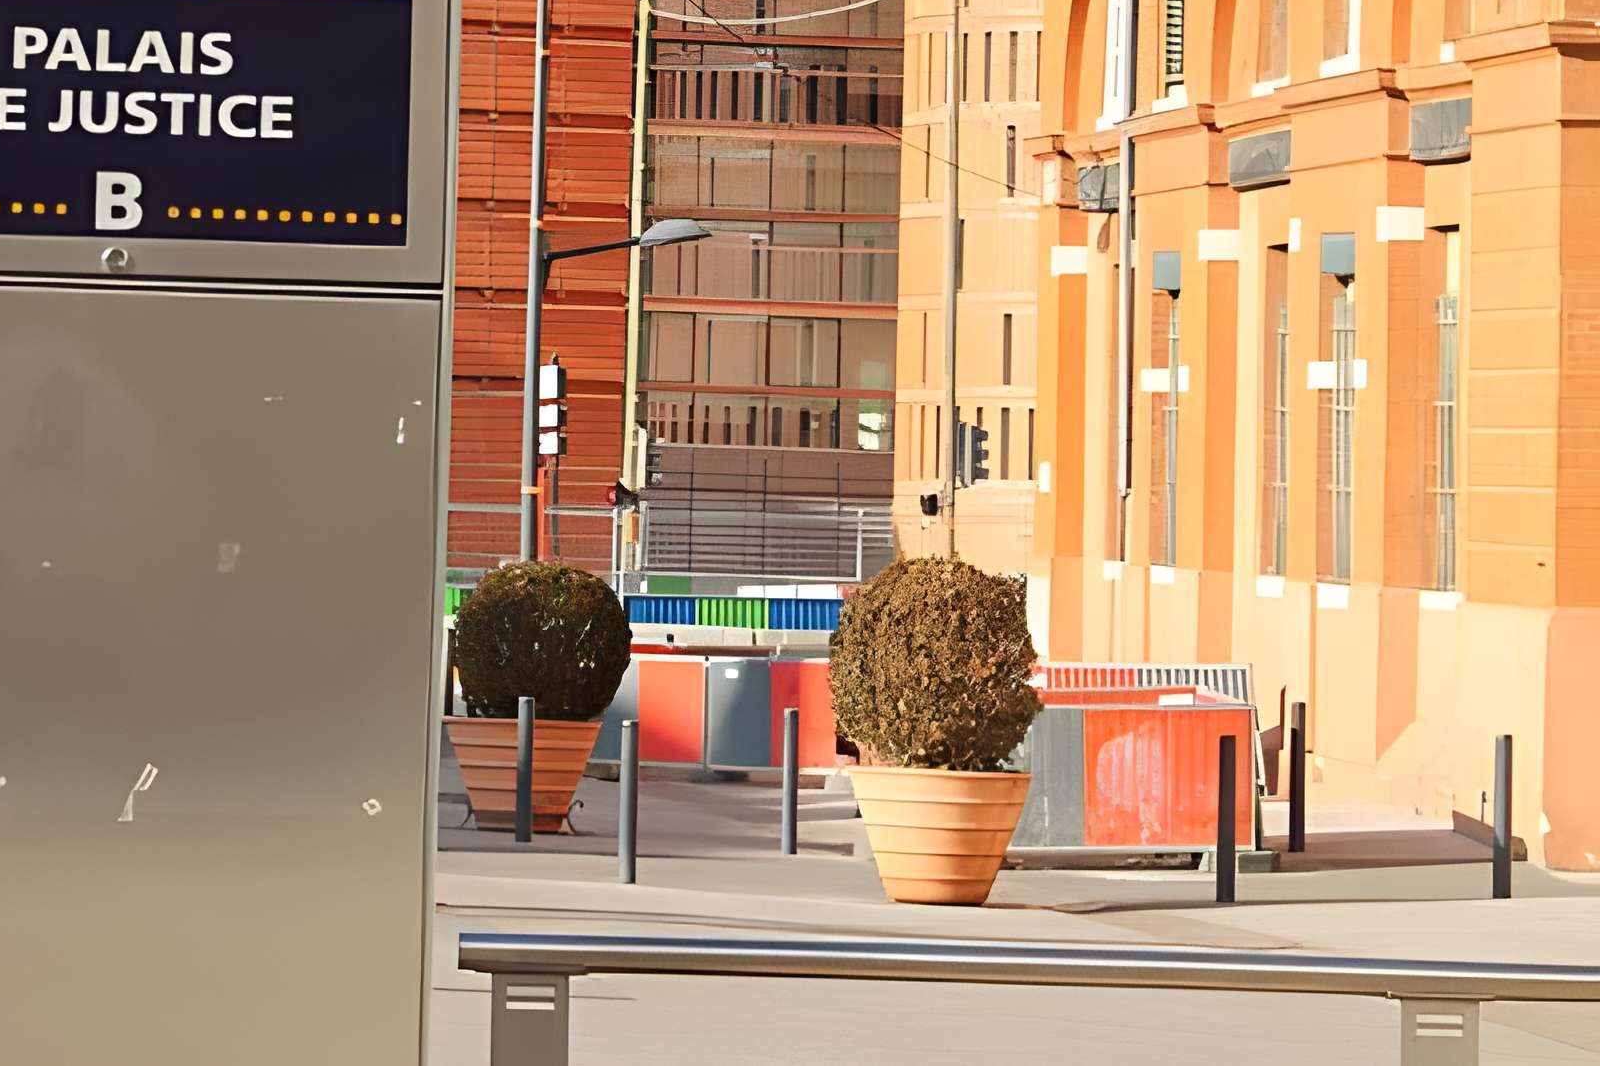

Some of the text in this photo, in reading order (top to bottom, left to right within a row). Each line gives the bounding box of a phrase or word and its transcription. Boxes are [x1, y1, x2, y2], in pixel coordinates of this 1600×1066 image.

[12, 26, 234, 76] PALAIS
[48, 89, 294, 139] JUSTICE
[94, 170, 143, 231] B
